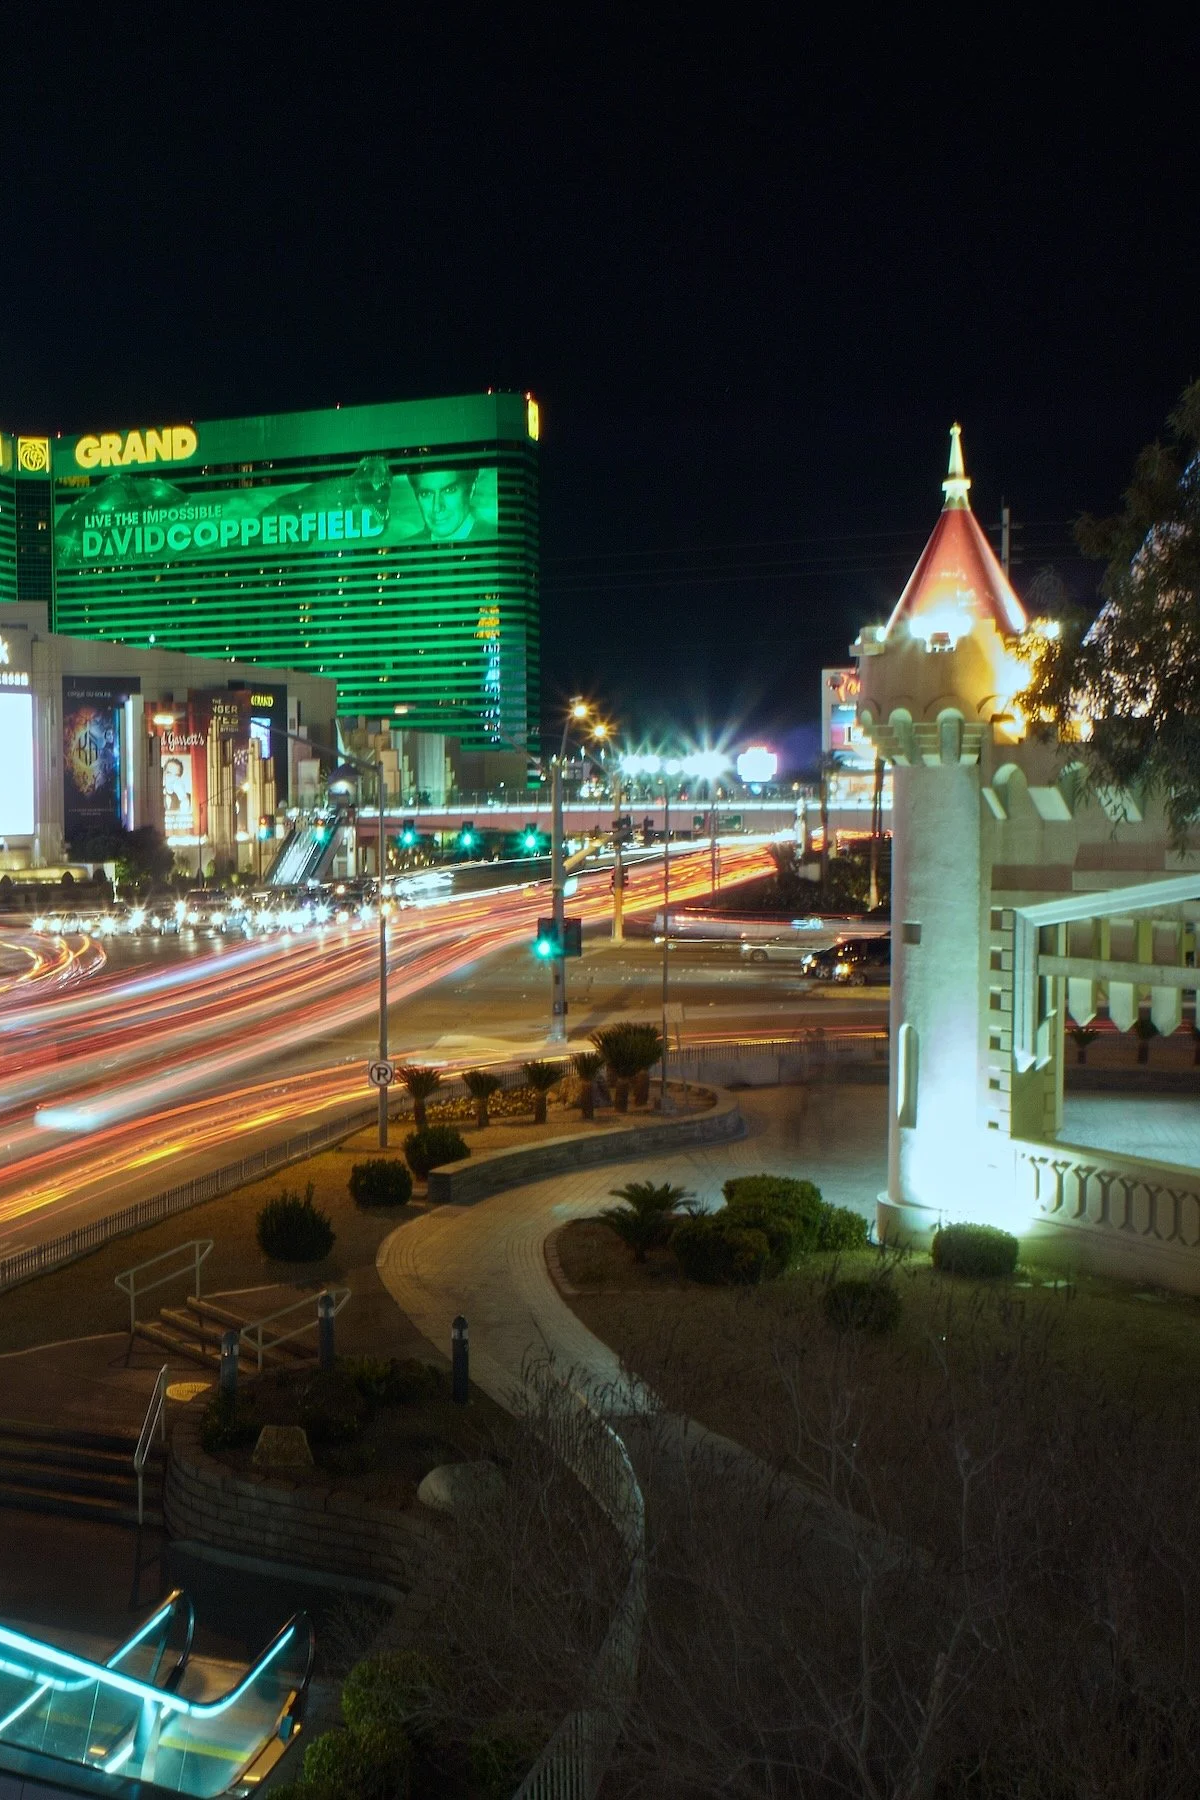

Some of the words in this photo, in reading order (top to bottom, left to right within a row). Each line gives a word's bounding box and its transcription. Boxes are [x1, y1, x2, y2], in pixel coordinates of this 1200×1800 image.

[74, 425, 198, 469] GRAND
[84, 514, 112, 529] LIVE
[114, 511, 139, 527] THE
[142, 504, 222, 524] IMPOSSIBLE
